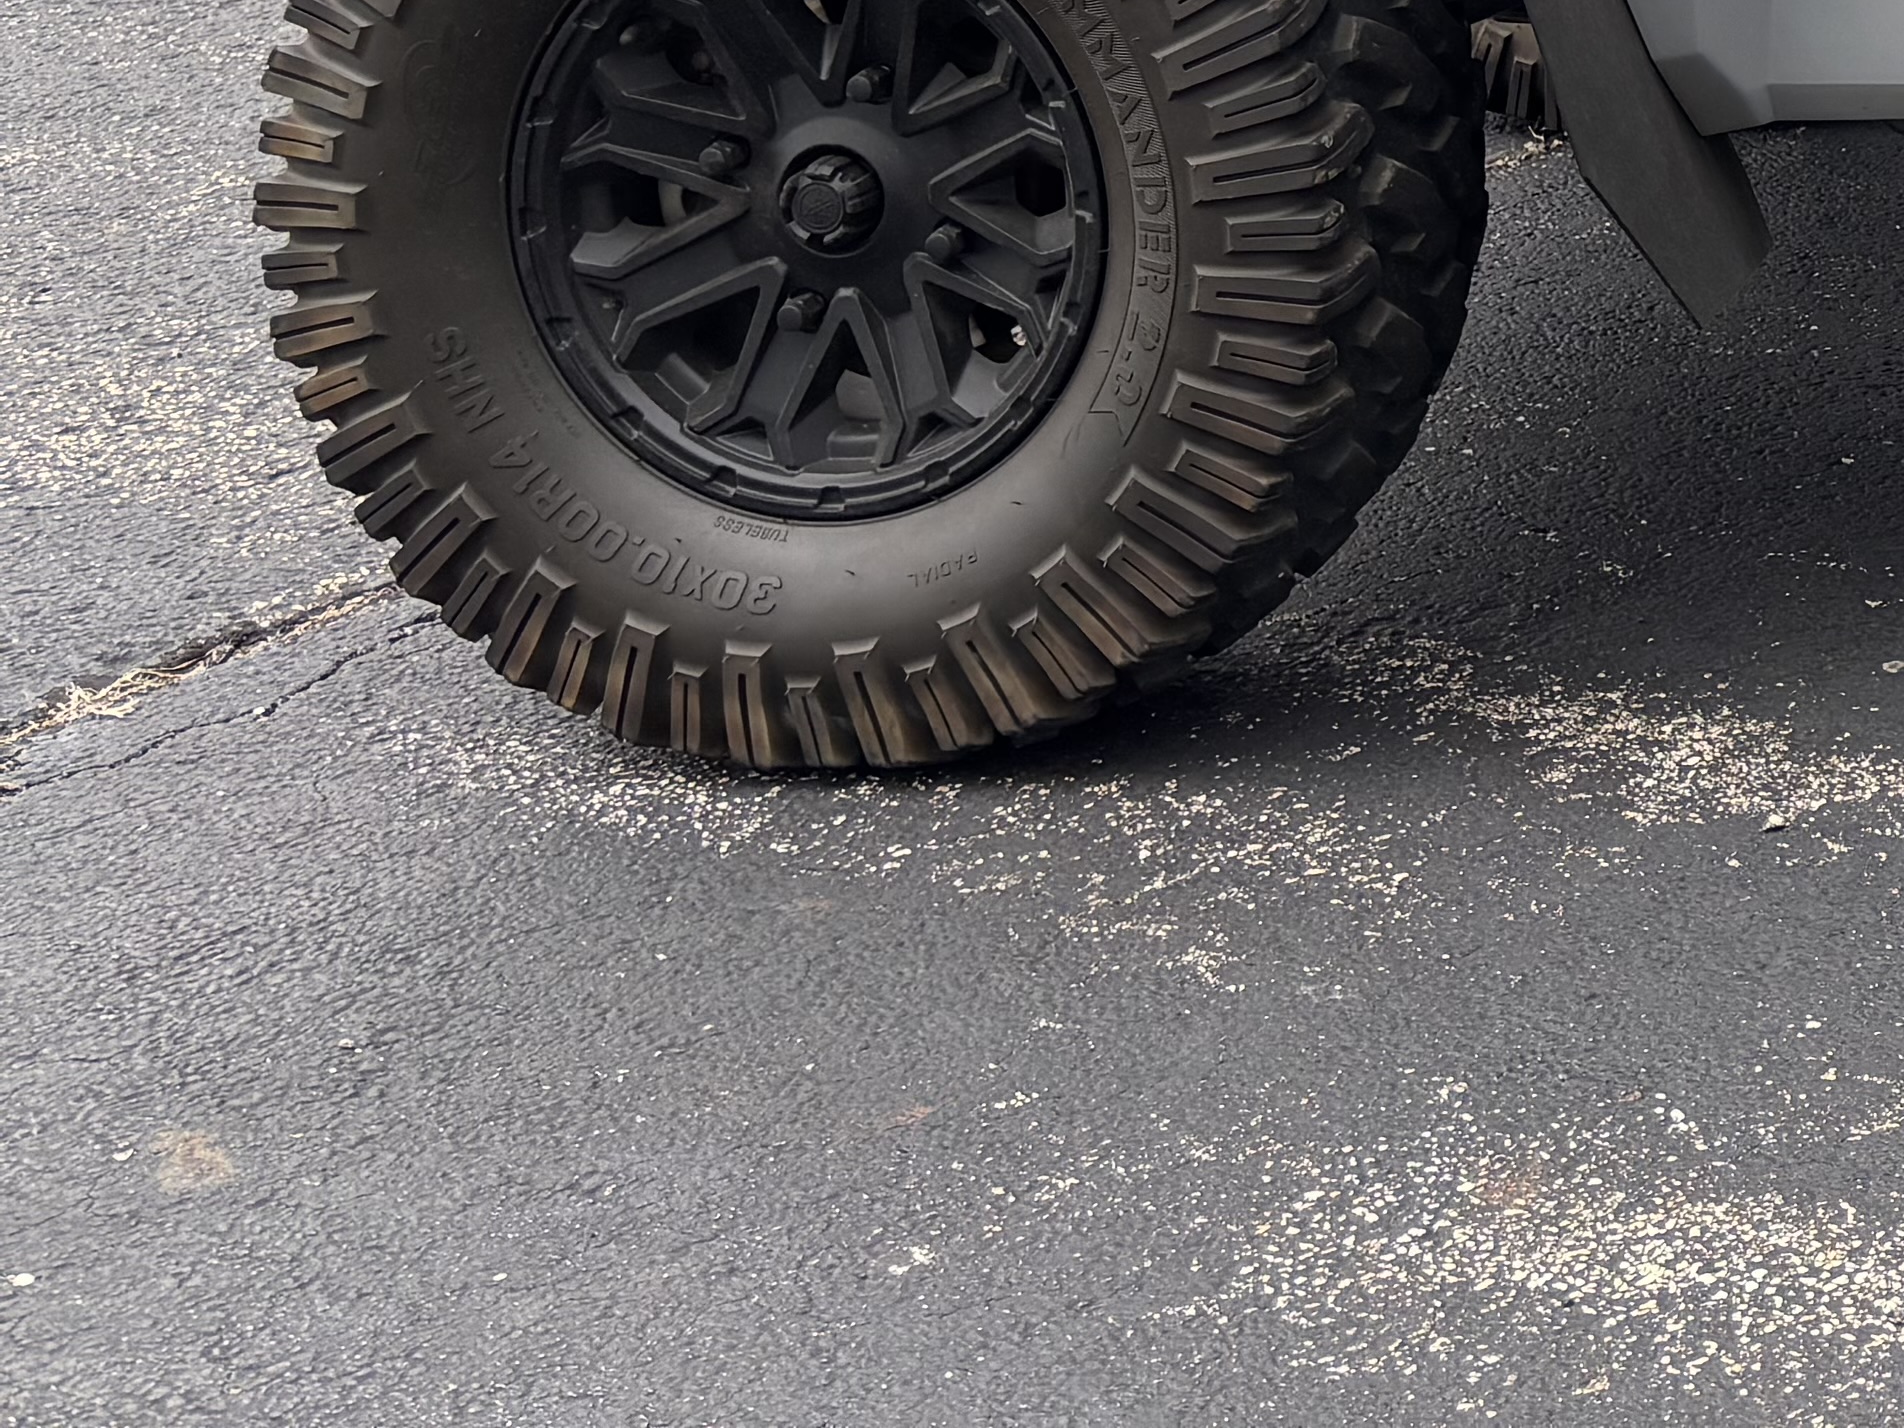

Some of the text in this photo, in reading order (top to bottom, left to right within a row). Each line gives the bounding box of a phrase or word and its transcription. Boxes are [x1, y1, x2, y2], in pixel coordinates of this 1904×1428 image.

[424, 326, 505, 434] NHS
[713, 513, 790, 543] TUBELESS
[905, 550, 980, 589] RADIAL
